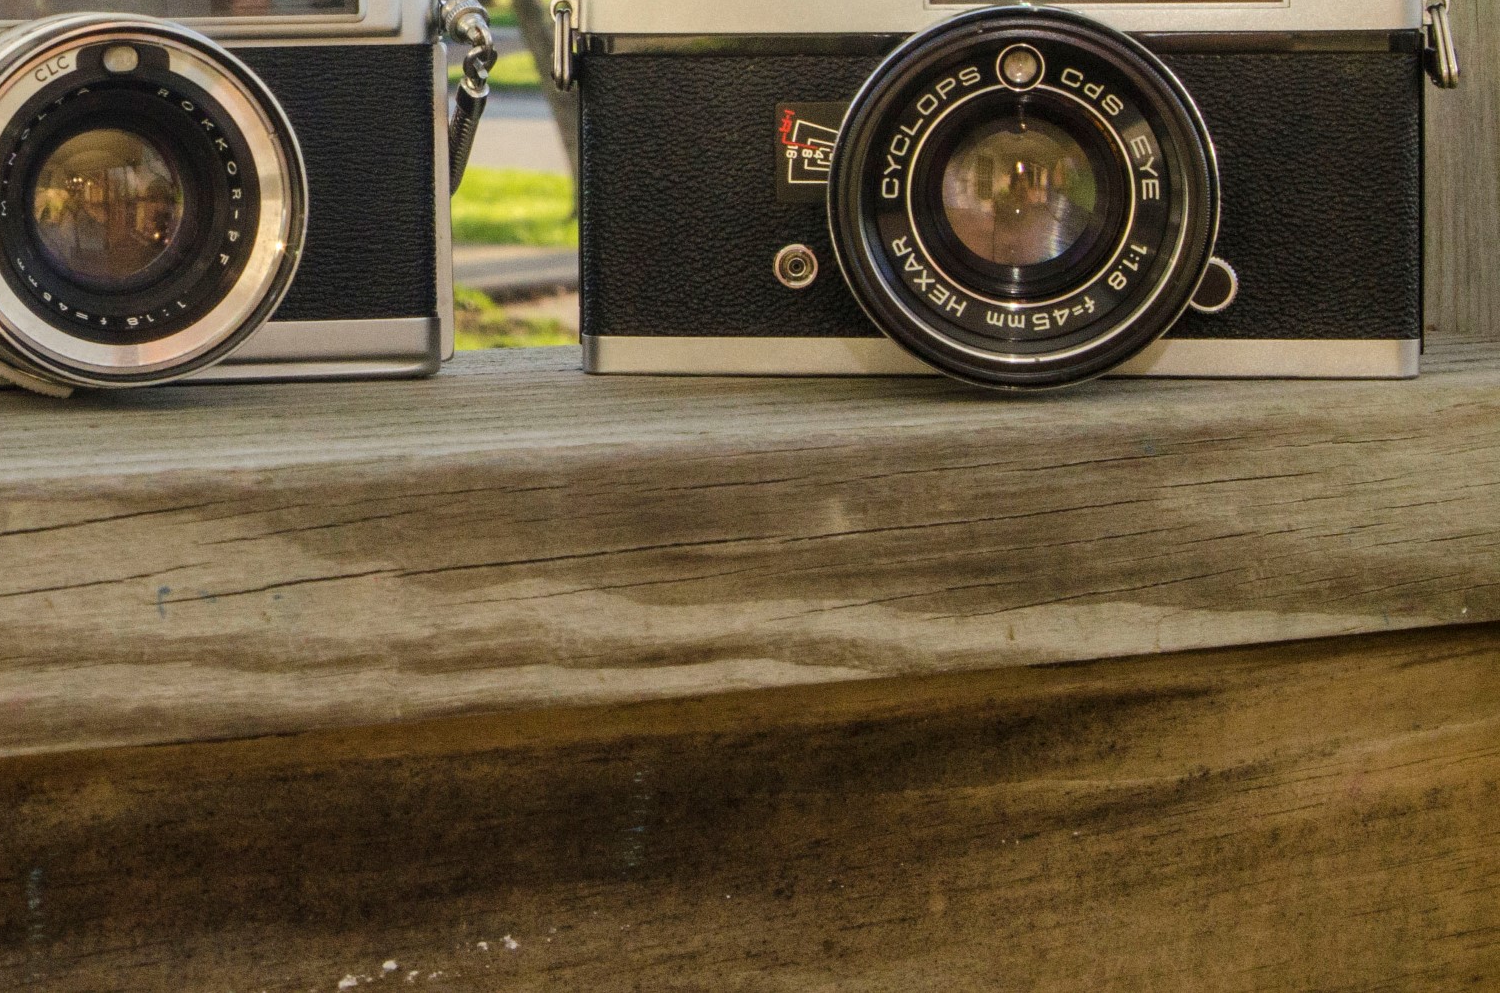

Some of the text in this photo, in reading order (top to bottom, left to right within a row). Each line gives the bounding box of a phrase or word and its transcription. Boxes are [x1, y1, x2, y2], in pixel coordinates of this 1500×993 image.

[35, 55, 70, 82] CLC
[882, 65, 1159, 201] CYCLOPS CdS EYE
[892, 235, 1148, 331] 1:1.8 f=45mm HEXAR
